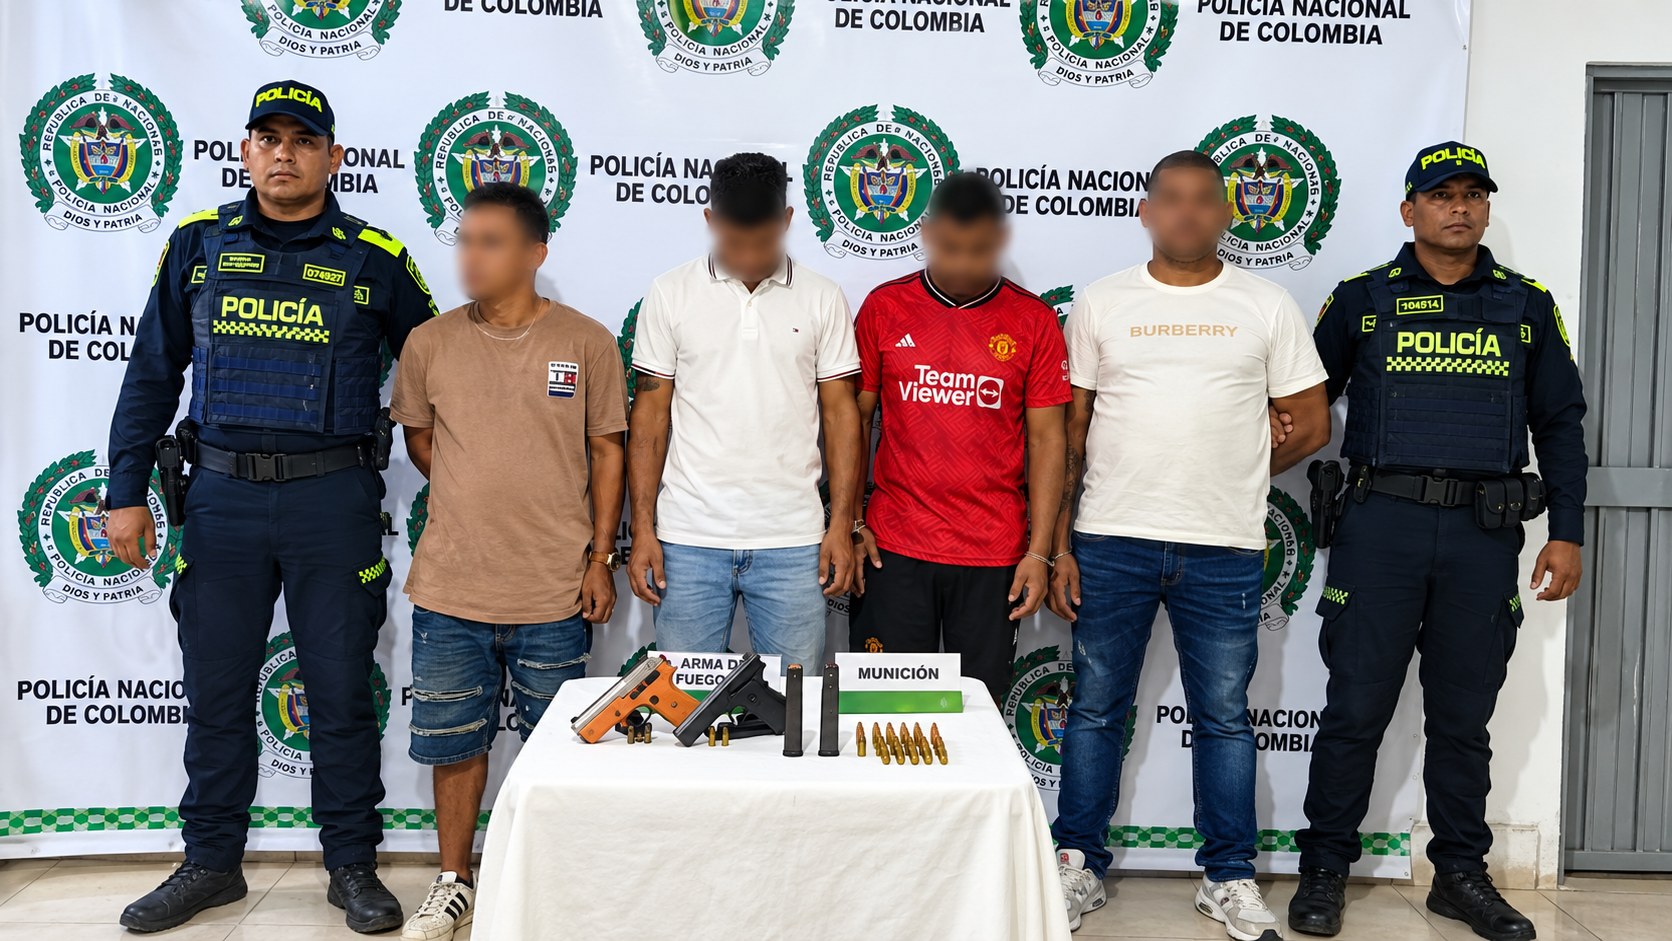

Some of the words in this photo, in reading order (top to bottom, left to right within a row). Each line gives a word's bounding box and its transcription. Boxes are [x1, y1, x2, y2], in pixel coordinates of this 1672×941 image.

[444, 0, 473, 12] DE
[480, 0, 604, 18] COLOMBIA
[1291, 0, 1411, 19] NACIONAL
[320, 8, 377, 40] NACIONAL
[834, 7, 864, 29] DE
[869, 8, 985, 33] COLOMBIA
[713, 24, 768, 56] NACIONAL
[1219, 21, 1250, 42] DE
[1257, 21, 1383, 45] COLOMBIA
[278, 36, 307, 53] DIOS
[309, 46, 317, 55] Y
[320, 40, 362, 55] PATRIA
[1095, 36, 1150, 69] NACIONAL
[673, 53, 700, 69] DIOS
[703, 62, 711, 71] Y
[713, 56, 753, 72] PATRIA
[1055, 66, 1082, 83] DIOS
[1085, 75, 1093, 84] Y
[1095, 69, 1135, 84] PATRIA
[94, 92, 110, 102] DE
[488, 110, 504, 120] DE
[876, 123, 892, 133] DE
[1255, 134, 1271, 143] DE
[590, 152, 677, 178] POLICÍA
[103, 181, 157, 214] NACIONAL
[616, 182, 645, 202] DE
[1035, 195, 1141, 217] COLOMBI
[63, 210, 91, 227] DIOS
[93, 219, 101, 228] Y
[103, 213, 143, 229] PATRIA
[1256, 220, 1311, 251] NACIONAL
[841, 239, 867, 256] DIOS
[870, 248, 877, 257] Y
[879, 242, 919, 257] PATRIA
[1217, 248, 1242, 264] DIOS
[1245, 257, 1253, 266] Y
[1255, 251, 1294, 266] PATRIA
[221, 296, 324, 327] POLICÍA
[19, 310, 113, 335] POLICÍA
[1130, 324, 1238, 337] BURBERRY
[48, 339, 79, 360] DE
[1396, 328, 1502, 357] POLICÍA
[914, 364, 976, 389] Team
[898, 381, 975, 406] Viewer
[62, 584, 90, 600] DIOS
[92, 591, 100, 600] Y
[103, 586, 144, 601] PATRIA
[680, 658, 723, 670] ARMA
[858, 664, 939, 681] MUNICIÓN
[17, 675, 111, 701] POLICÍA
[46, 705, 77, 725] DE
[84, 704, 188, 725] COLOMBI
[271, 759, 297, 774] DIOS
[300, 767, 307, 776] Y
[1049, 780, 1056, 788] Y
